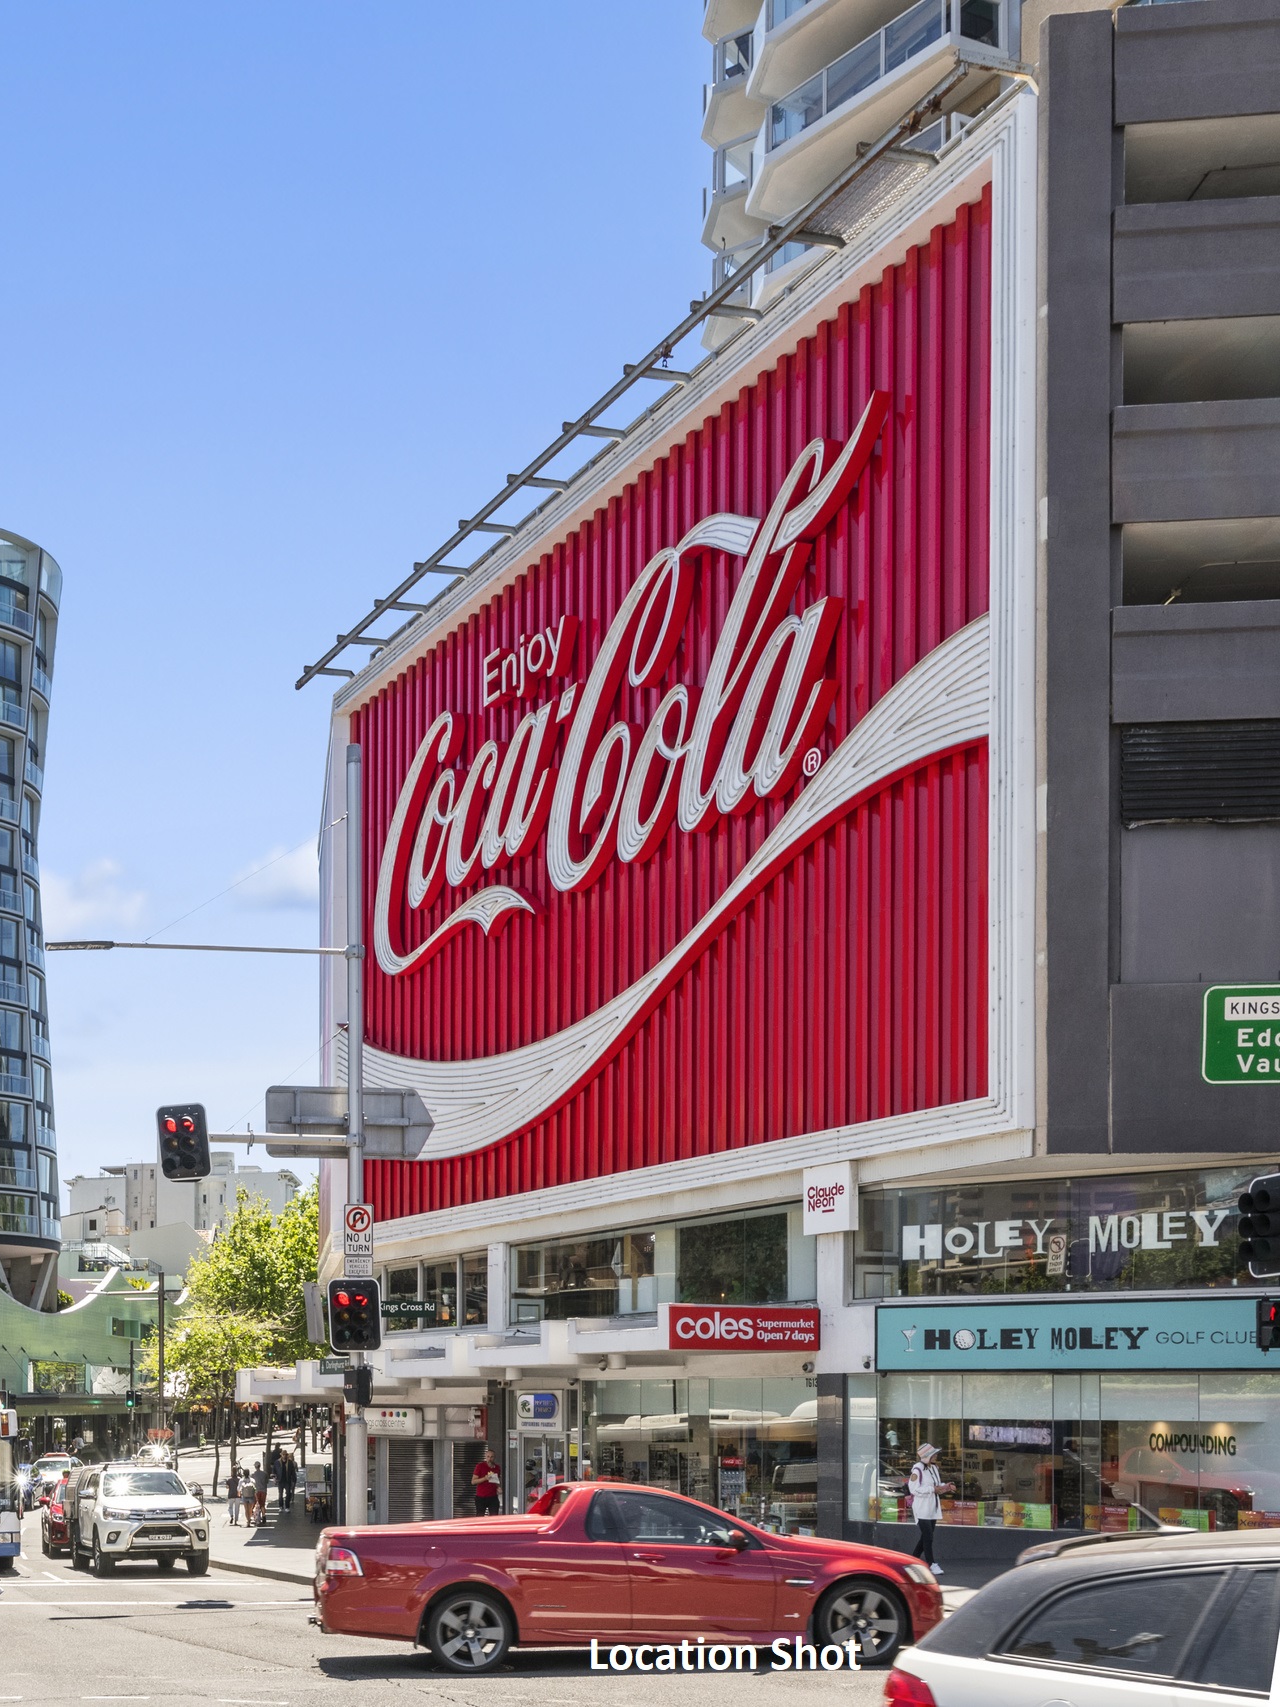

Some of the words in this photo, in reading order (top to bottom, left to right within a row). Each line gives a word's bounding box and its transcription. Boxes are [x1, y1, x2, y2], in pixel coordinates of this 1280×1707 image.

[483, 615, 567, 708] Enjoy
[373, 390, 884, 976] Coca-Cola
[1230, 1002, 1280, 1014] KINGS
[807, 1182, 845, 1200] Claude
[807, 1195, 835, 1213] Neon
[346, 1233, 360, 1243] NO
[364, 1232, 371, 1243] U
[901, 1218, 1056, 1261] HOLEY
[1088, 1209, 1230, 1253] MOLEY
[347, 1244, 370, 1253] TURN
[380, 1302, 399, 1313] Kings
[400, 1303, 423, 1311] Cross
[424, 1302, 435, 1311] Rd
[676, 1311, 755, 1340] coles
[756, 1318, 815, 1330] Supermarket
[756, 1330, 783, 1343] Open
[784, 1331, 791, 1341] 7
[791, 1330, 815, 1344] days
[1051, 1327, 1149, 1350] MOLEY
[1155, 1331, 1206, 1345] GOLF
[1149, 1432, 1237, 1457] COMPOUNDING
